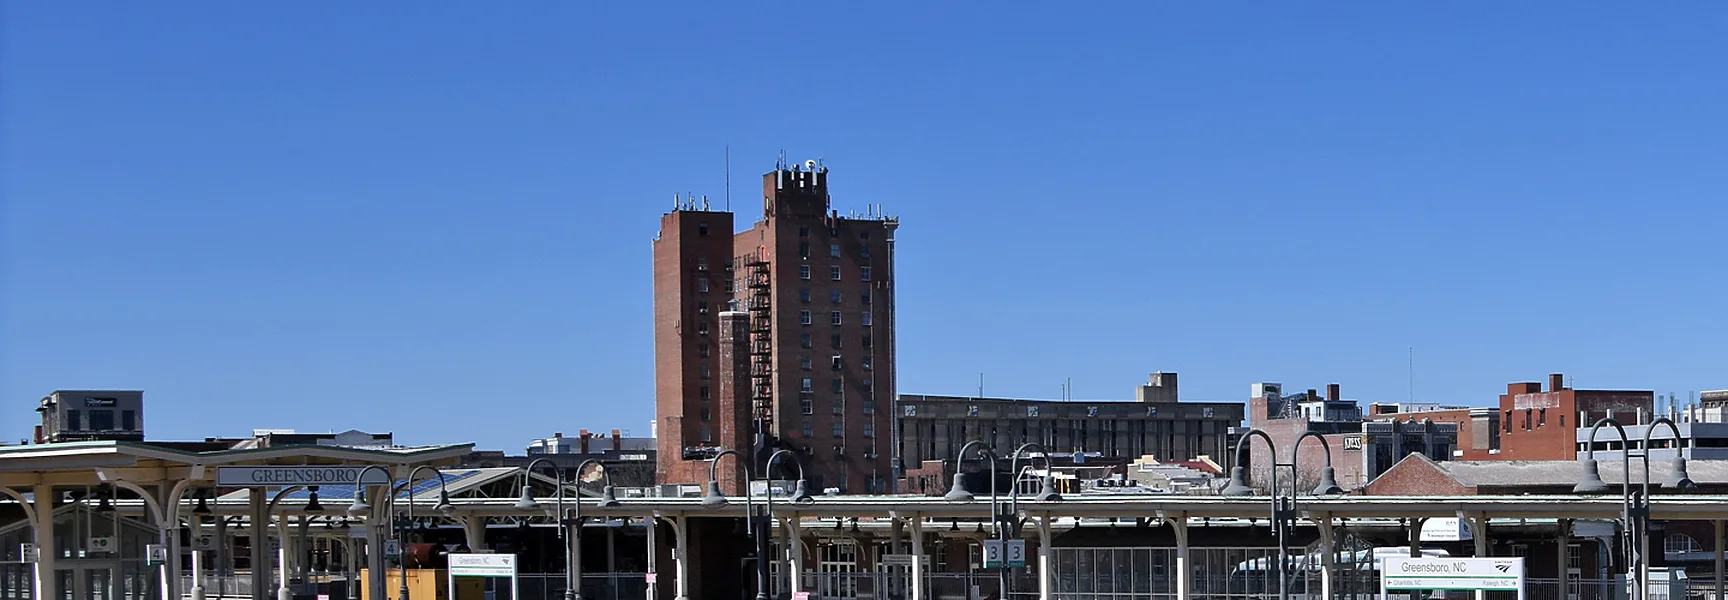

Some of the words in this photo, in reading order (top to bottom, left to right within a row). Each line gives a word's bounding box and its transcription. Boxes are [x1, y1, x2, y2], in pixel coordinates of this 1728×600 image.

[251, 469, 357, 482] GREENSBORO
[153, 549, 161, 559] 4
[387, 544, 395, 554] 4
[990, 546, 998, 559] 3
[1013, 546, 1021, 559] 3
[1401, 561, 1451, 573] Greensboro,
[1453, 561, 1467, 572] NC
